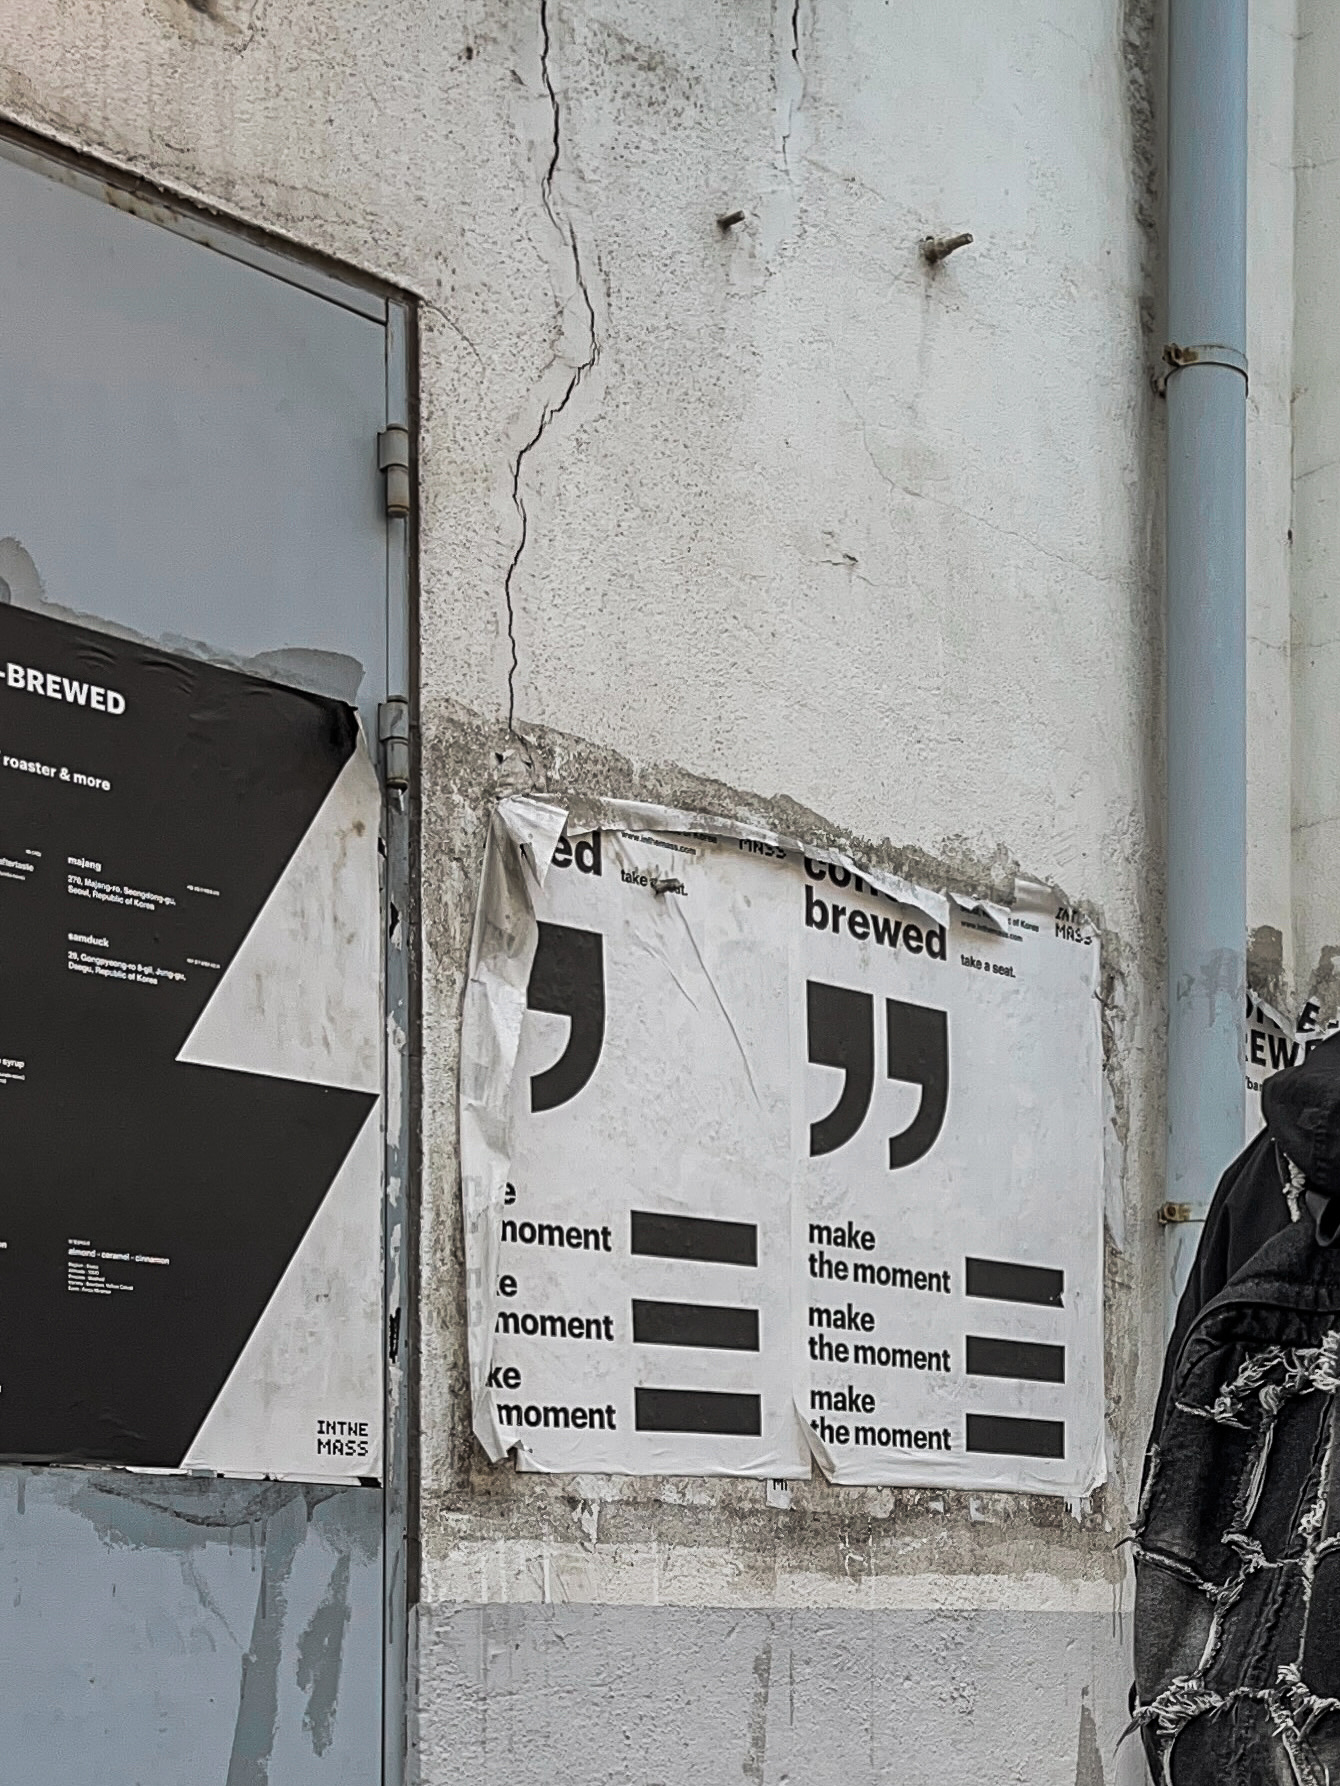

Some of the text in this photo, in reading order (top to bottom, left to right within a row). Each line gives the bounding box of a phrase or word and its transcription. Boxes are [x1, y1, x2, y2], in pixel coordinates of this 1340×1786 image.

[0, 662, 126, 715] -BREWED
[3, 755, 111, 791] roaster & more
[67, 856, 102, 872] majang
[620, 869, 648, 887] take
[804, 884, 947, 962] brewed
[67, 932, 109, 947] samduck
[961, 954, 1016, 979] take a seat.
[809, 1221, 875, 1251] make
[809, 1251, 951, 1294] the moment
[495, 1311, 614, 1341] moment
[809, 1303, 875, 1332] make
[809, 1333, 951, 1372] the moment
[810, 1385, 875, 1413] make
[497, 1403, 616, 1430] moment
[317, 1438, 368, 1456] MASS
[855, 1426, 951, 1450] moment
